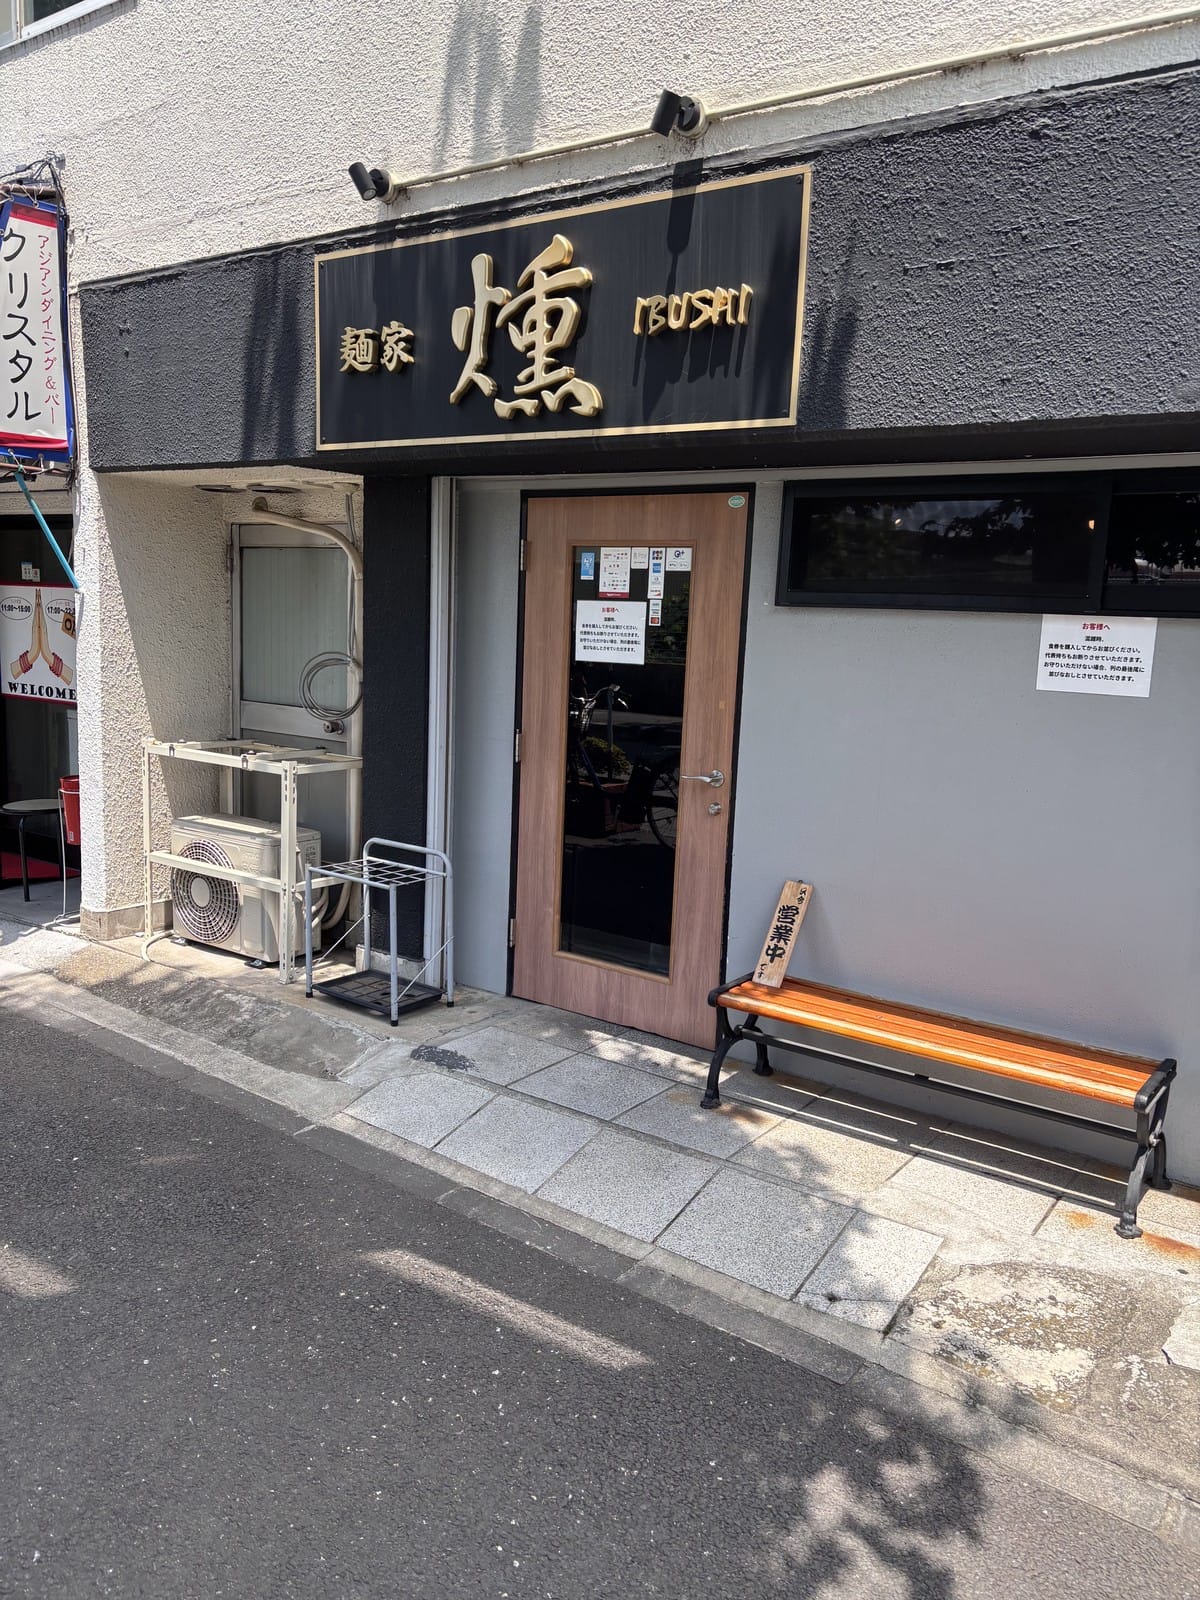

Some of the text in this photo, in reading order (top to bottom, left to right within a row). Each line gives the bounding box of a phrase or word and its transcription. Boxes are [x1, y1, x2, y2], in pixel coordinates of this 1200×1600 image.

[3, 227, 41, 420] クリスタル
[449, 233, 604, 420] 燻
[632, 283, 755, 337] IBUSHI
[338, 320, 415, 375] 麺家
[1081, 622, 1111, 631] お客様へ
[8, 681, 76, 701] WELCOME
[765, 904, 800, 964] 営業中
